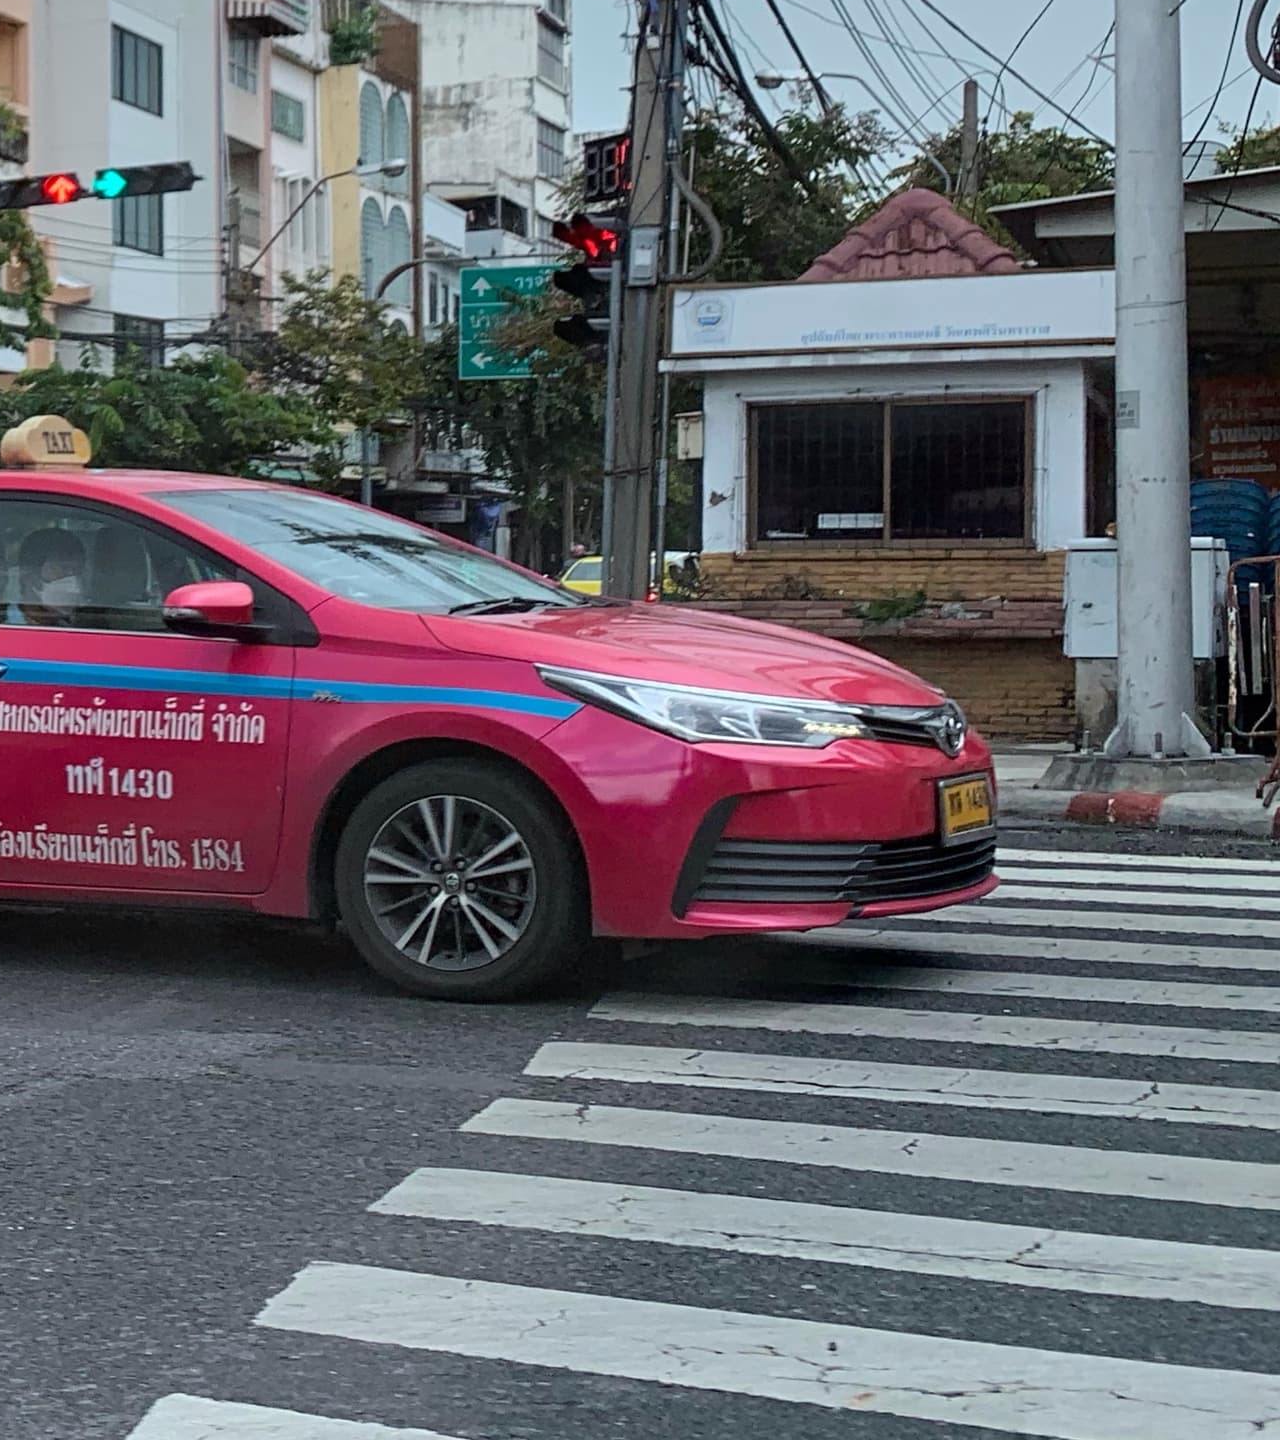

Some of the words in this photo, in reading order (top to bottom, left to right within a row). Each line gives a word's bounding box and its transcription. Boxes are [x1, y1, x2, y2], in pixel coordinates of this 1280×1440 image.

[42, 431, 75, 454] TAXI
[212, 702, 265, 744] จำกัด
[108, 767, 173, 799] 1430
[192, 839, 244, 872] 1584
